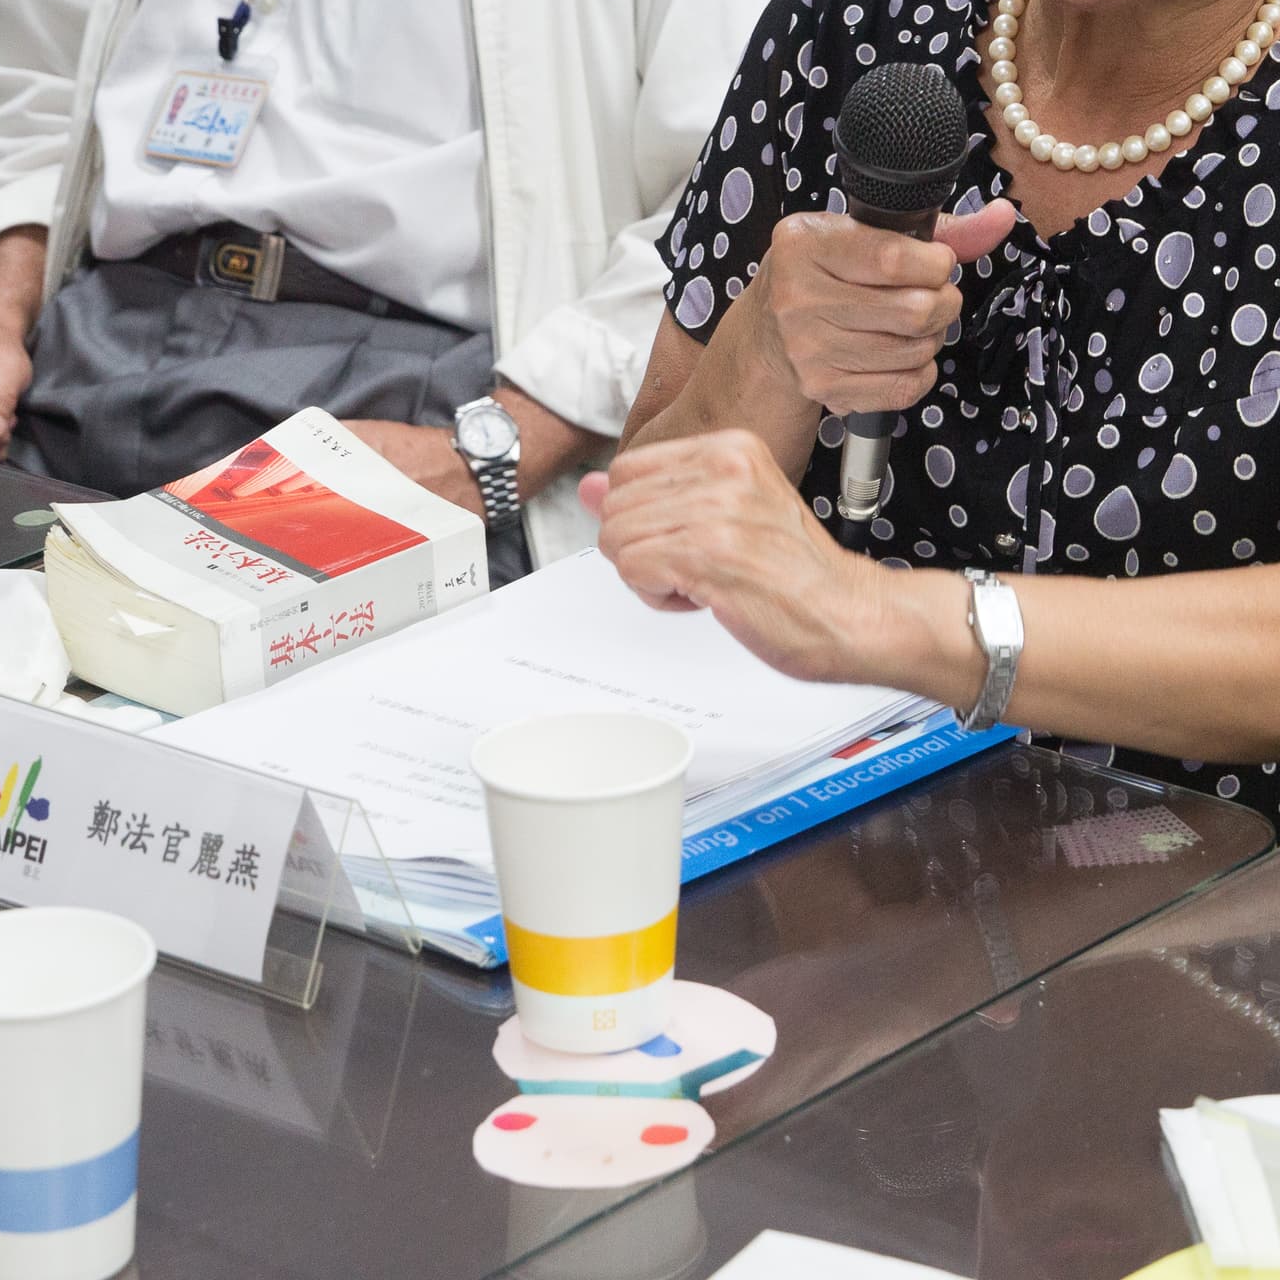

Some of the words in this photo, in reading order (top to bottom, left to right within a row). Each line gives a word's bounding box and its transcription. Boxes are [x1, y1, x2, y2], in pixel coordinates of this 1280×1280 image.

[184, 529, 296, 586] 基本六法
[269, 600, 375, 669] 基本六法
[759, 803, 793, 826] on
[806, 735, 951, 802] Educational
[951, 724, 986, 743] In
[87, 799, 261, 891] 鄭法官麗燕
